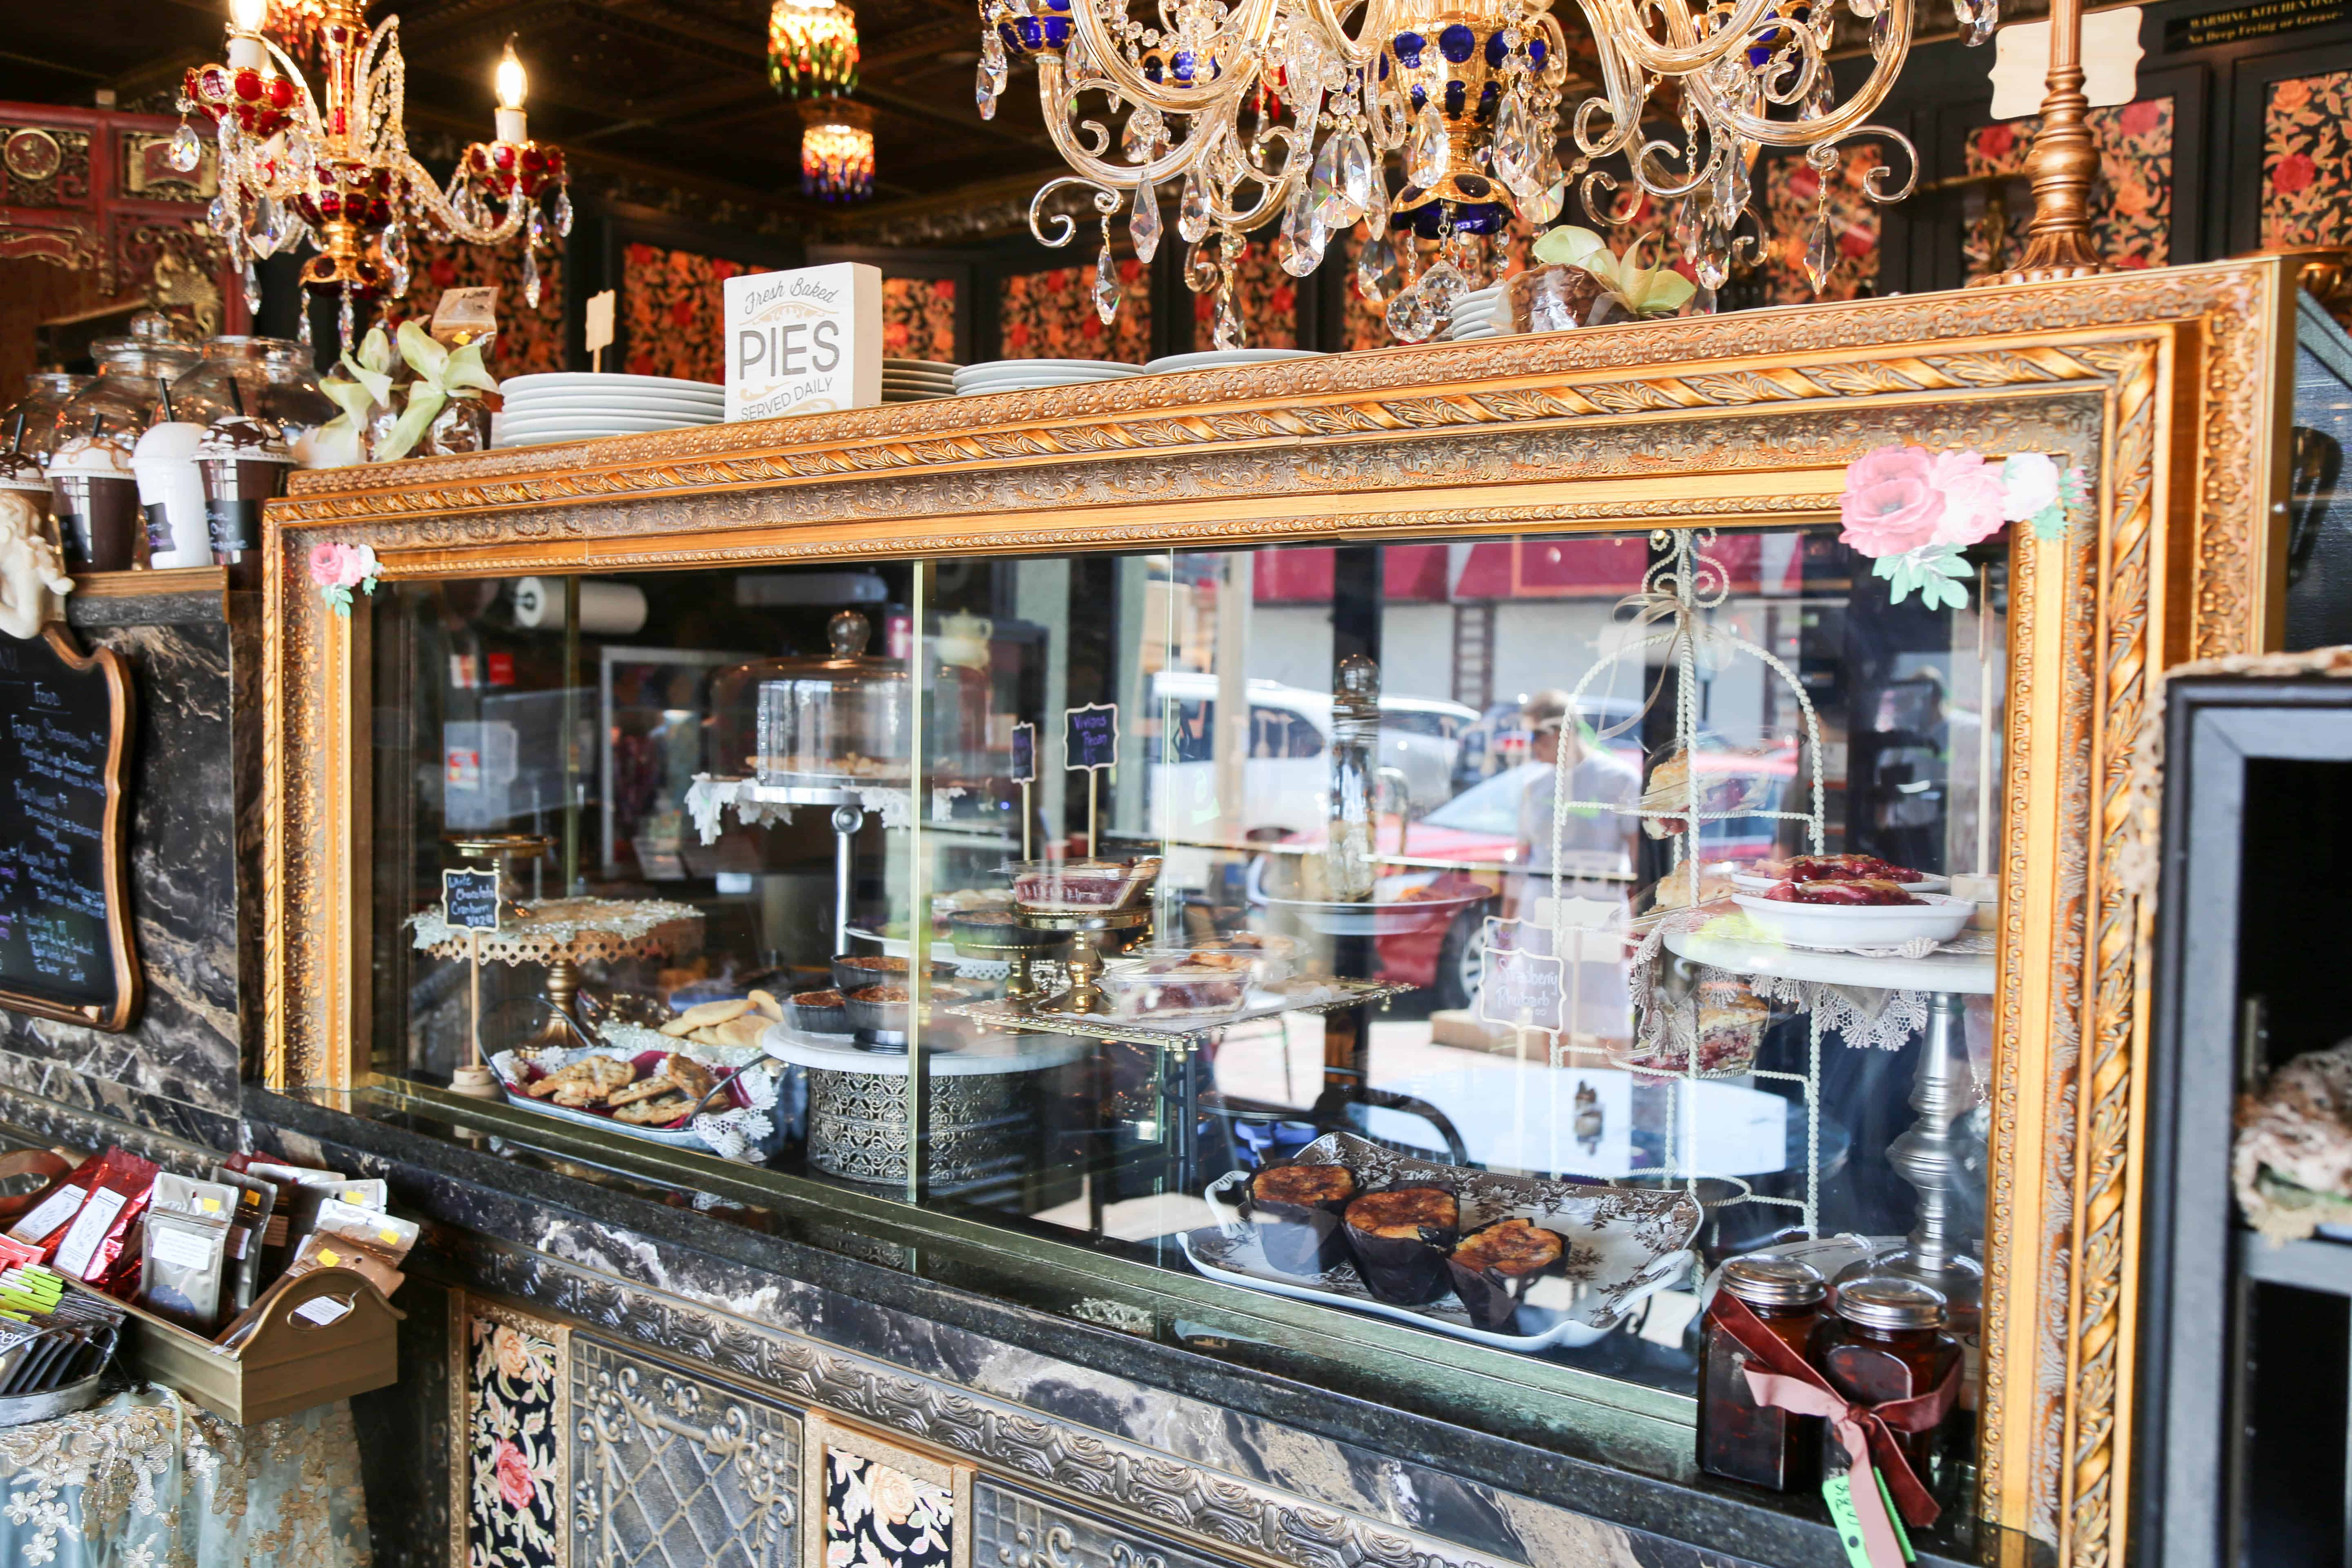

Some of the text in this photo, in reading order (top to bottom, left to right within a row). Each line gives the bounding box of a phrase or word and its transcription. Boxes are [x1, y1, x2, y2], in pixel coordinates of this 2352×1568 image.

[2190, 11, 2248, 28] WARMING
[2251, 0, 2307, 18] KITCHEN
[2189, 34, 2204, 44] No
[2206, 30, 2236, 41] Deep
[2239, 21, 2276, 36] Frying
[2279, 19, 2294, 29] or
[744, 277, 840, 314] Fresh Baked
[739, 320, 840, 380] PIES
[741, 376, 833, 421] SERVED DAILY
[1082, 731, 1107, 745] Pecan
[1496, 986, 1550, 1010] Rhubarb
